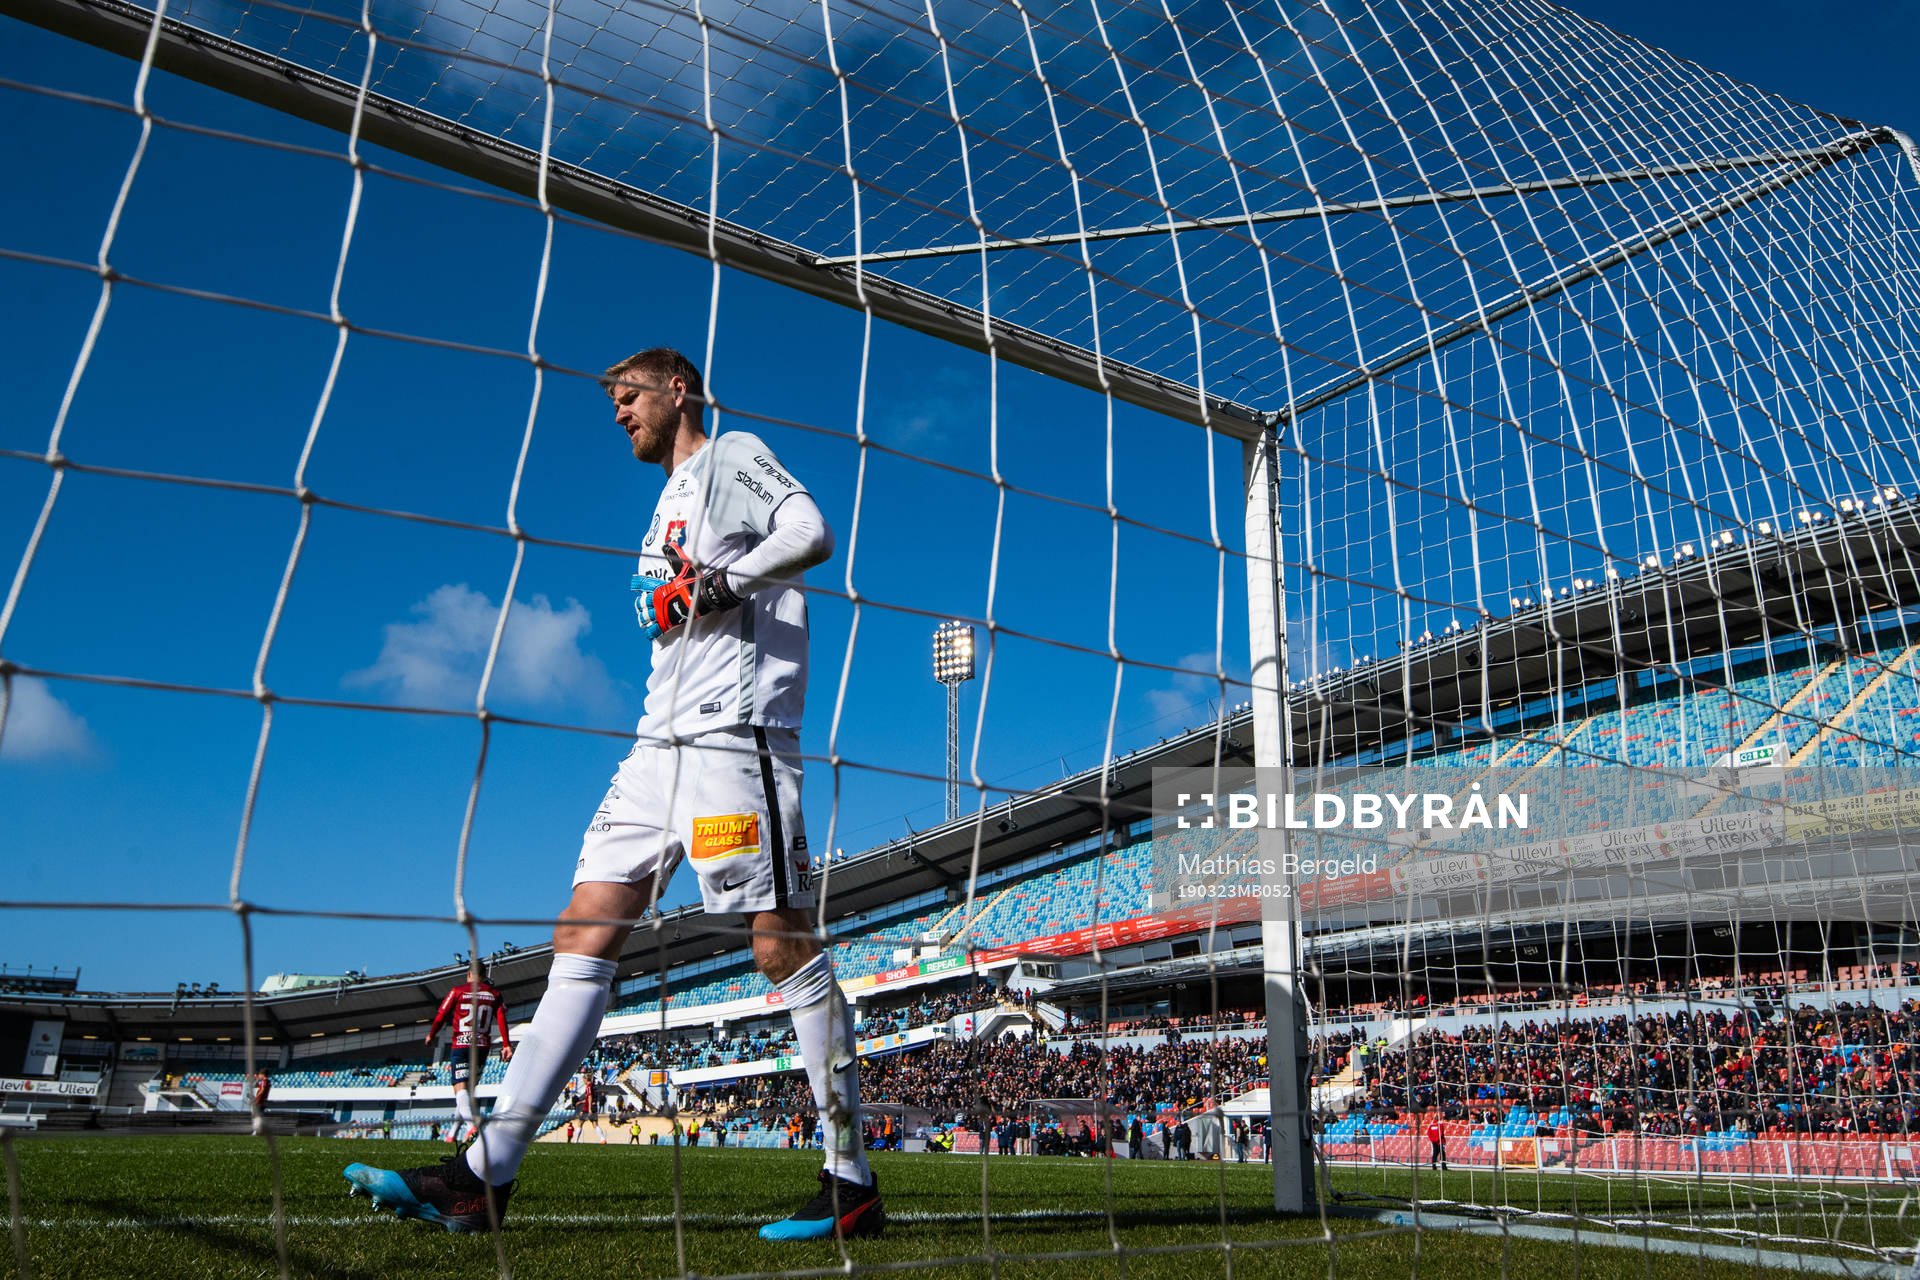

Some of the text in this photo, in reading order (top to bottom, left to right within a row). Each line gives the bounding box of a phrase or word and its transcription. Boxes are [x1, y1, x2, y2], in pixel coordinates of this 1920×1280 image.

[735, 470, 774, 505] stadium
[697, 820, 752, 836] TRIUMF
[1700, 814, 1752, 834] Ullevi
[704, 835, 743, 847] GLASS
[1600, 828, 1647, 848] Ullevi
[1510, 843, 1553, 862] Ullevi
[926, 958, 959, 973] REPEAT.
[885, 969, 909, 982] SHOP.
[458, 1003, 494, 1034] 20
[58, 1083, 96, 1095] Ullevi
